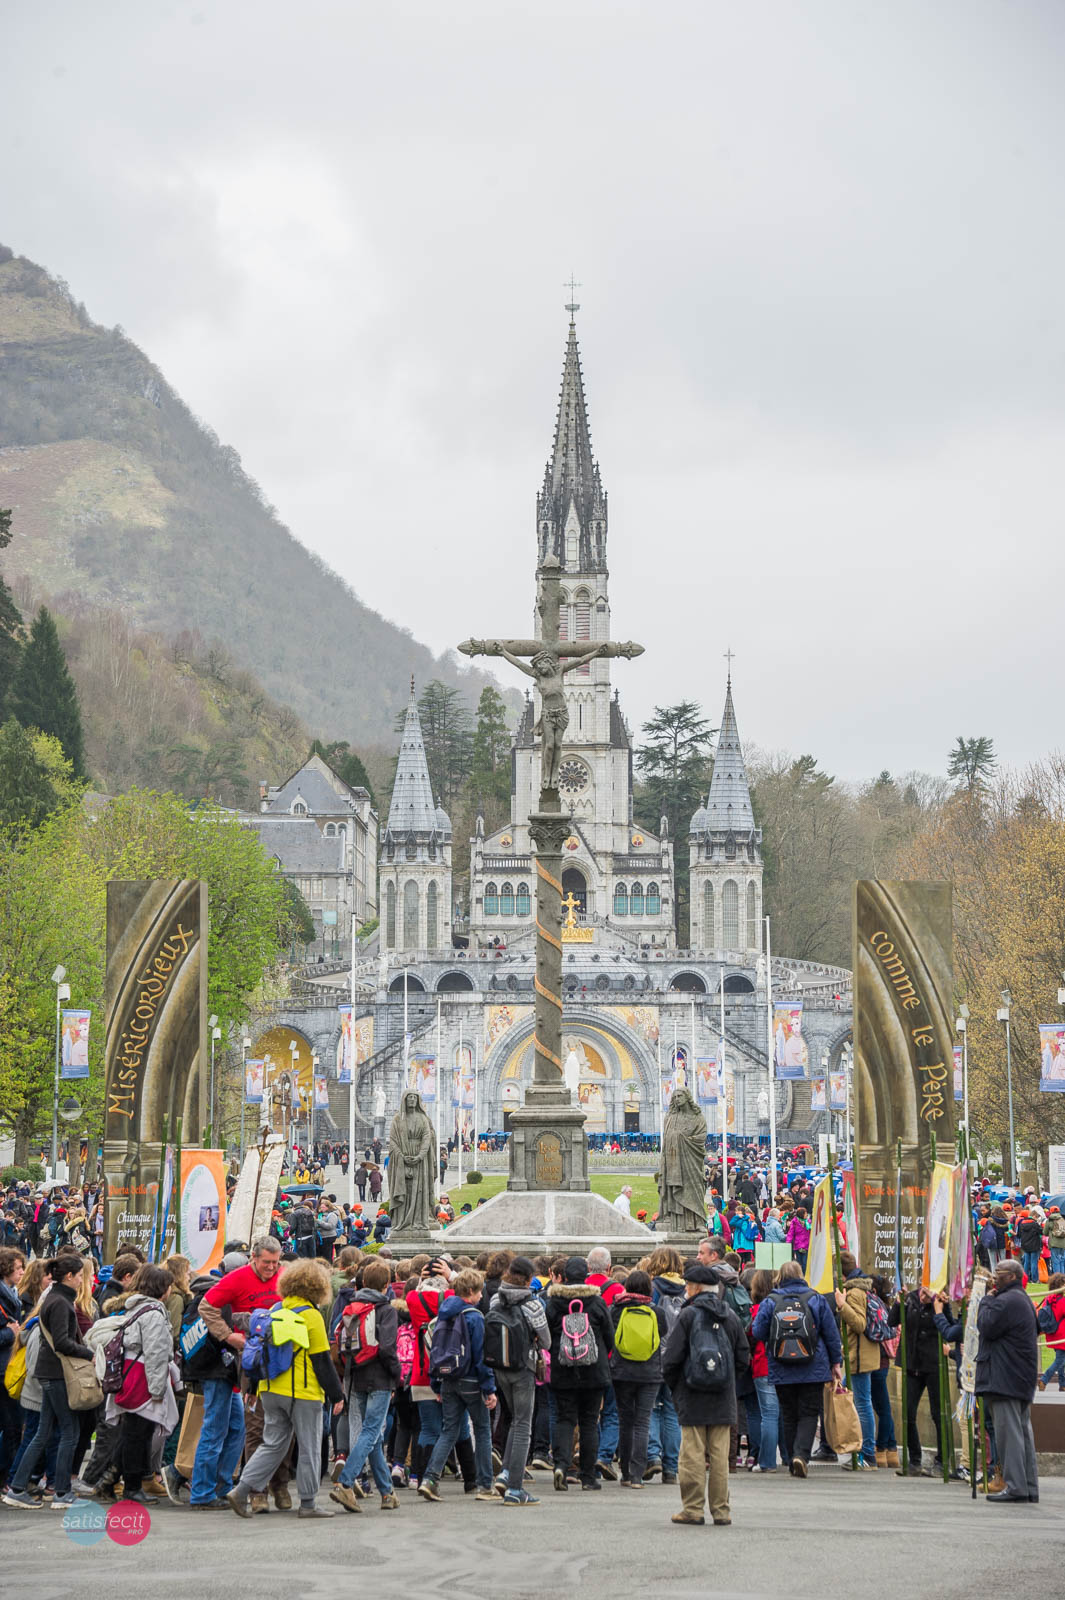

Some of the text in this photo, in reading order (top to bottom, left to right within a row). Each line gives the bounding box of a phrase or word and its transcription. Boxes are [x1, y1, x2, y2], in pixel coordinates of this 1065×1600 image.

[911, 1024, 934, 1048] le
[117, 1210, 151, 1227] Chiunque
[873, 1212, 925, 1227] Quicoue en
[874, 1230, 896, 1242] pourr
[182, 1317, 209, 1354] NIKE
